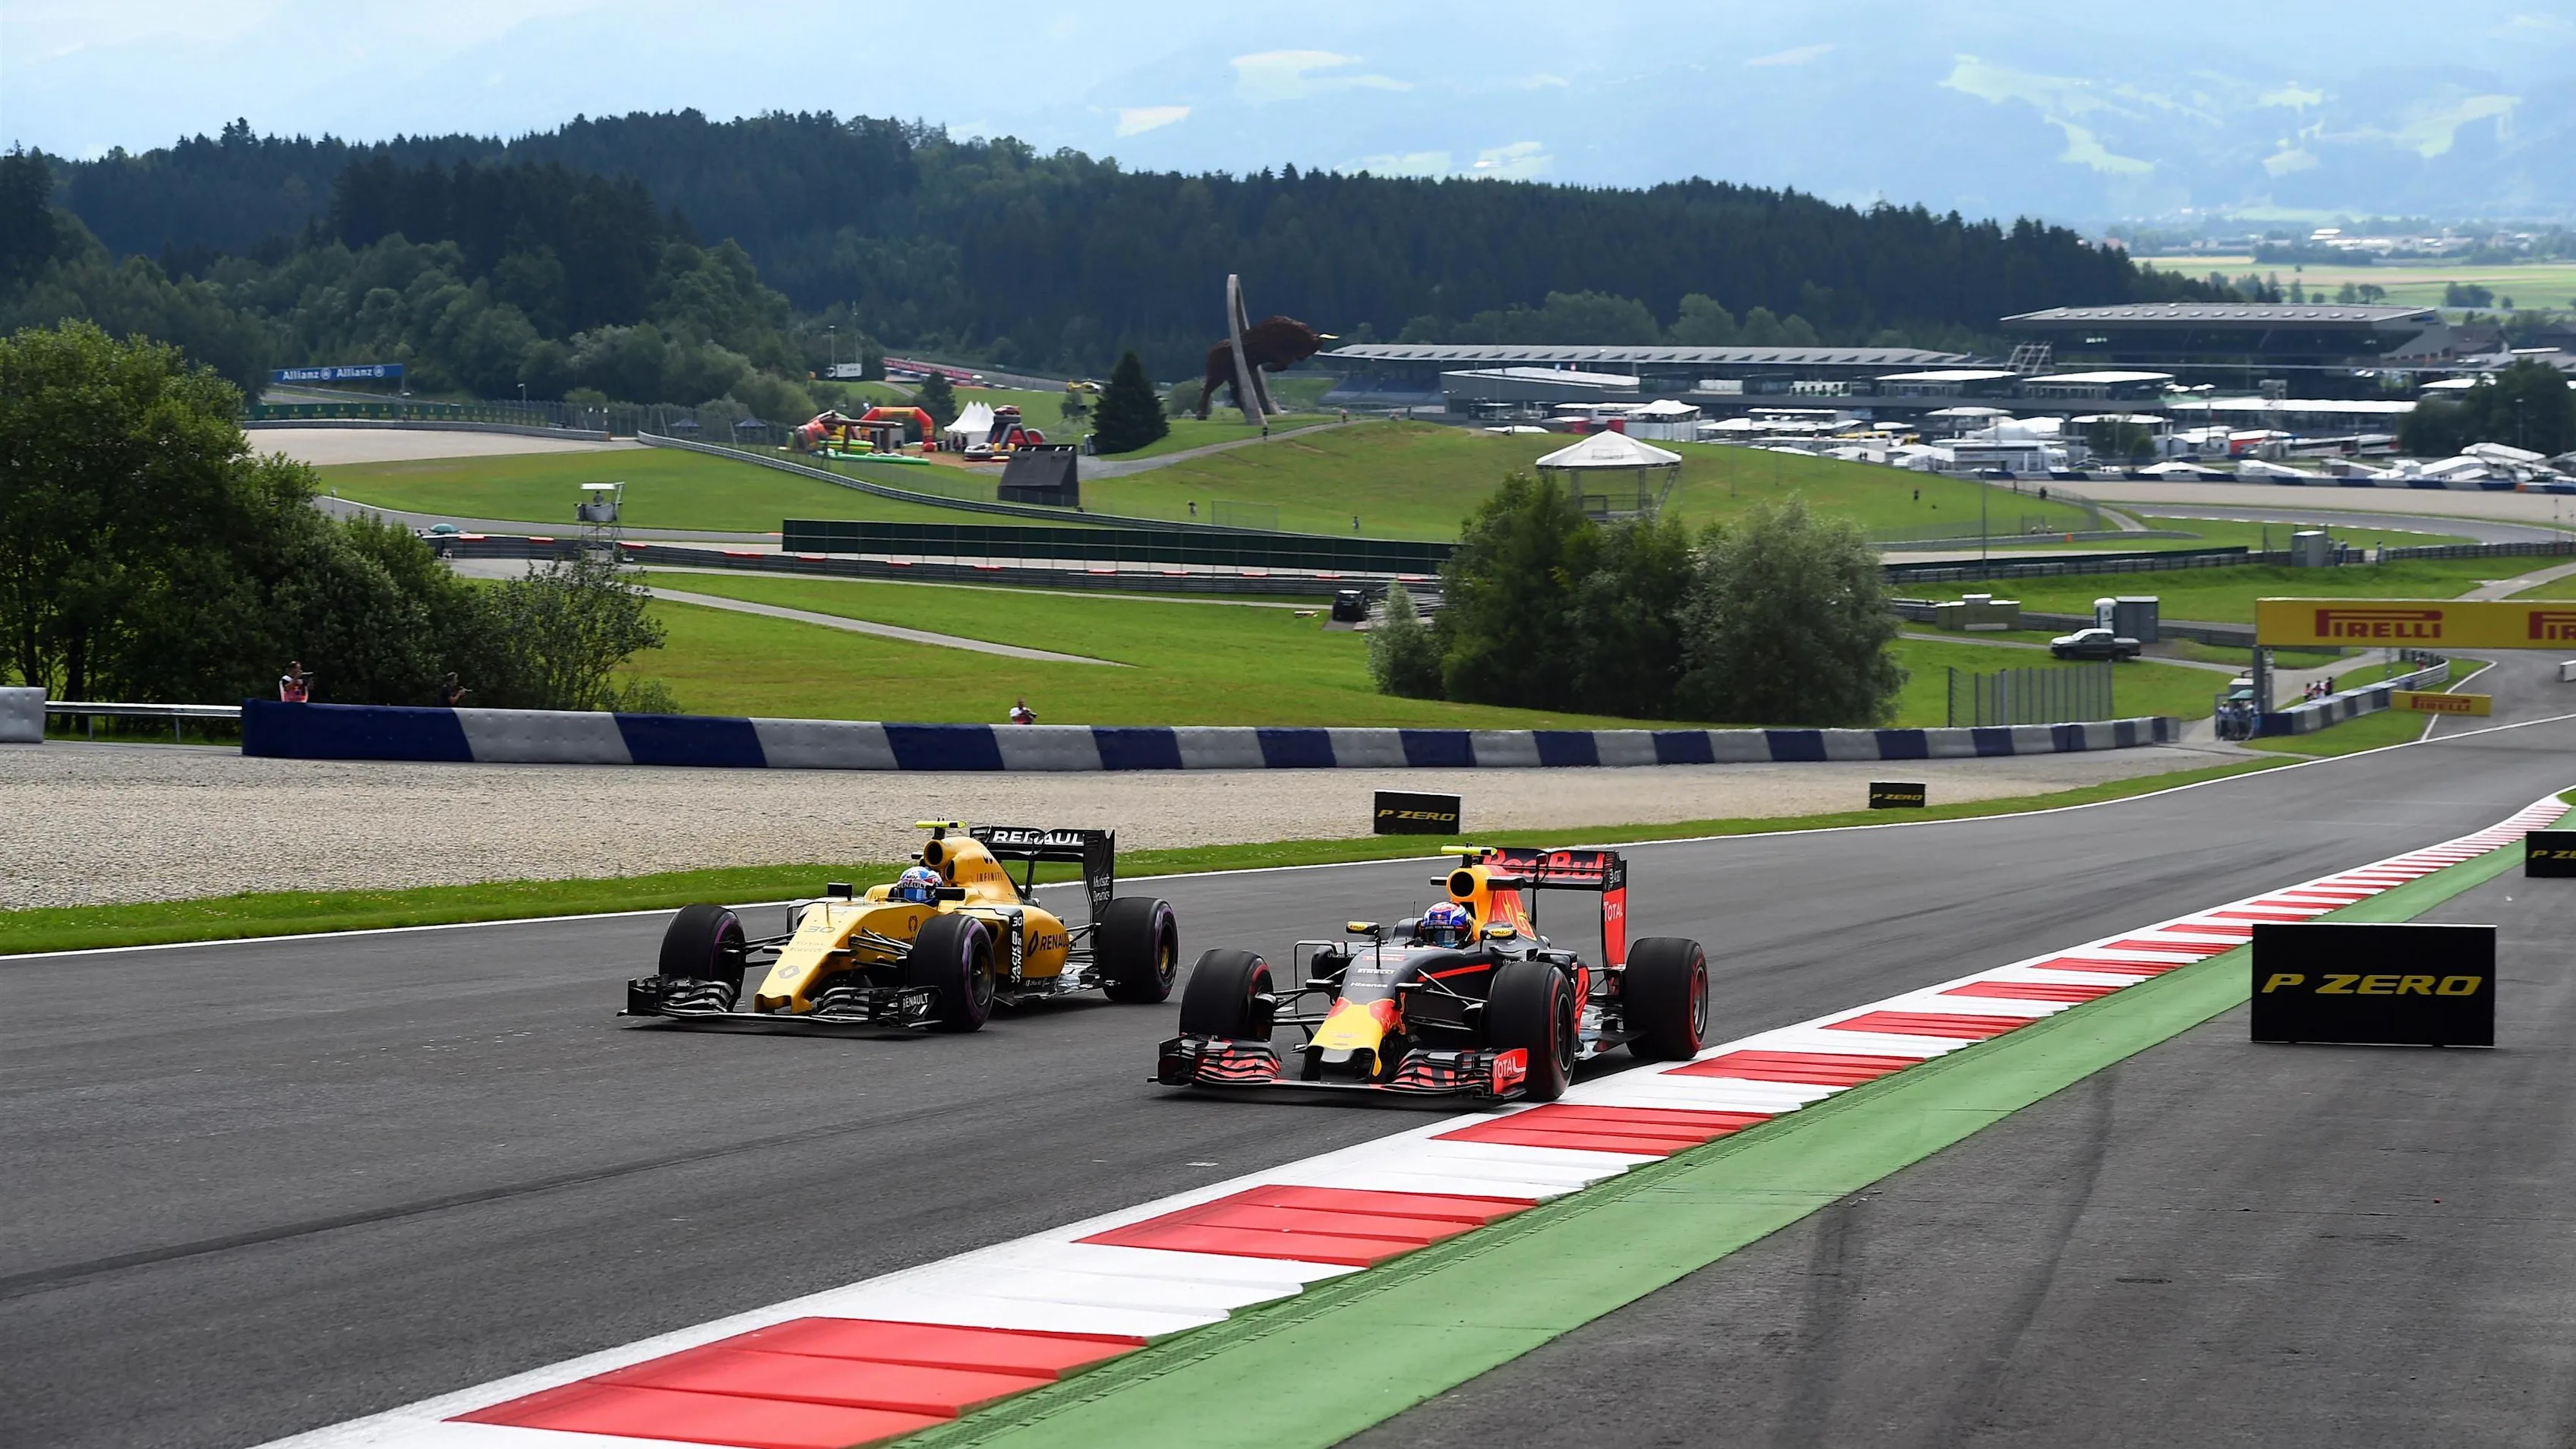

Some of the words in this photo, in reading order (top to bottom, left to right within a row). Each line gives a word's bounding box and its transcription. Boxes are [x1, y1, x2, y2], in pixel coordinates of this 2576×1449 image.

[283, 371, 320, 380] Allianz
[336, 368, 373, 377] Allianz
[2316, 609, 2443, 638] PIRELLI
[2411, 696, 2472, 712] PIRELLI
[1378, 810, 1394, 818] P
[1397, 810, 1457, 822] ZERO
[992, 831, 1084, 846] RENAUL
[2530, 850, 2549, 859] P
[1603, 901, 1623, 921] TOTAL
[1012, 917, 1022, 927] 30
[2262, 974, 2305, 993] P
[2315, 974, 2483, 996] ZERO
[1493, 1056, 1526, 1078] TOTAL
